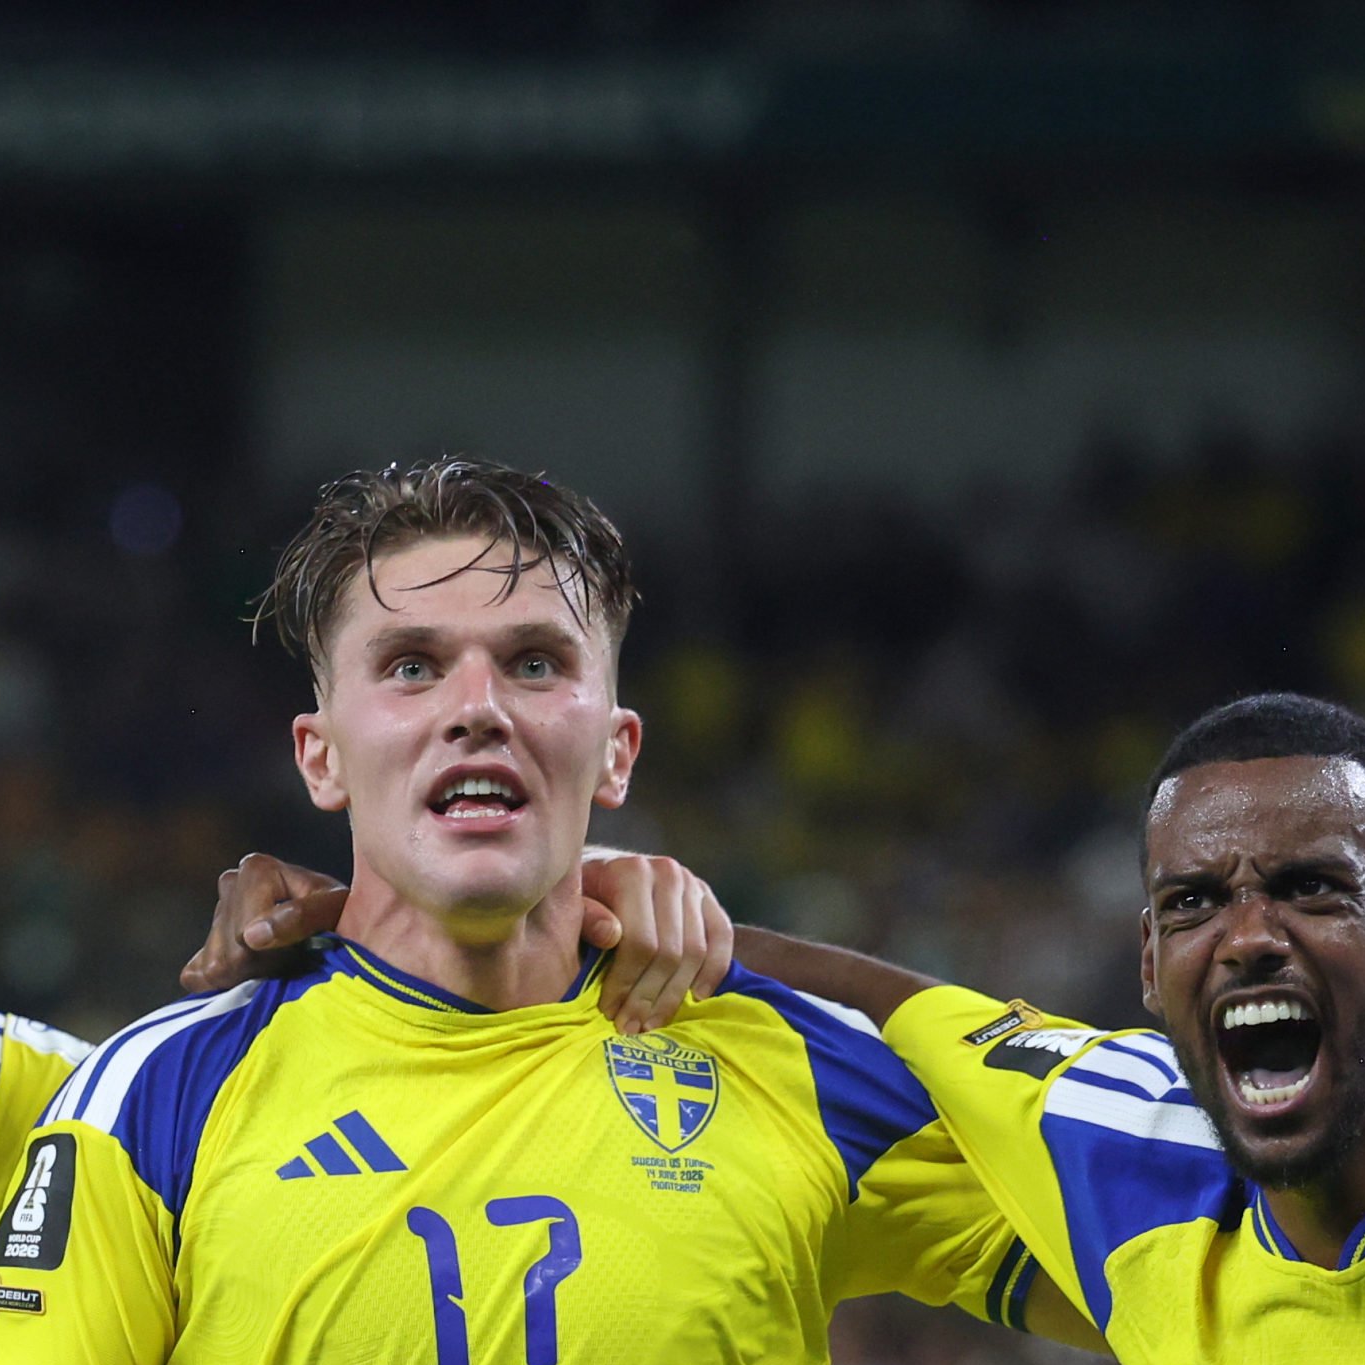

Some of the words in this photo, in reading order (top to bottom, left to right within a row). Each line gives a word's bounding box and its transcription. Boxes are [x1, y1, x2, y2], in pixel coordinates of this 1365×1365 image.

[621, 1047, 698, 1071] SVERIGE
[680, 1170, 704, 1181] 2026
[19, 1212, 34, 1223] FIFA
[8, 1234, 26, 1243] WORLD
[26, 1234, 42, 1243] CUP
[4, 1243, 40, 1258] 2026
